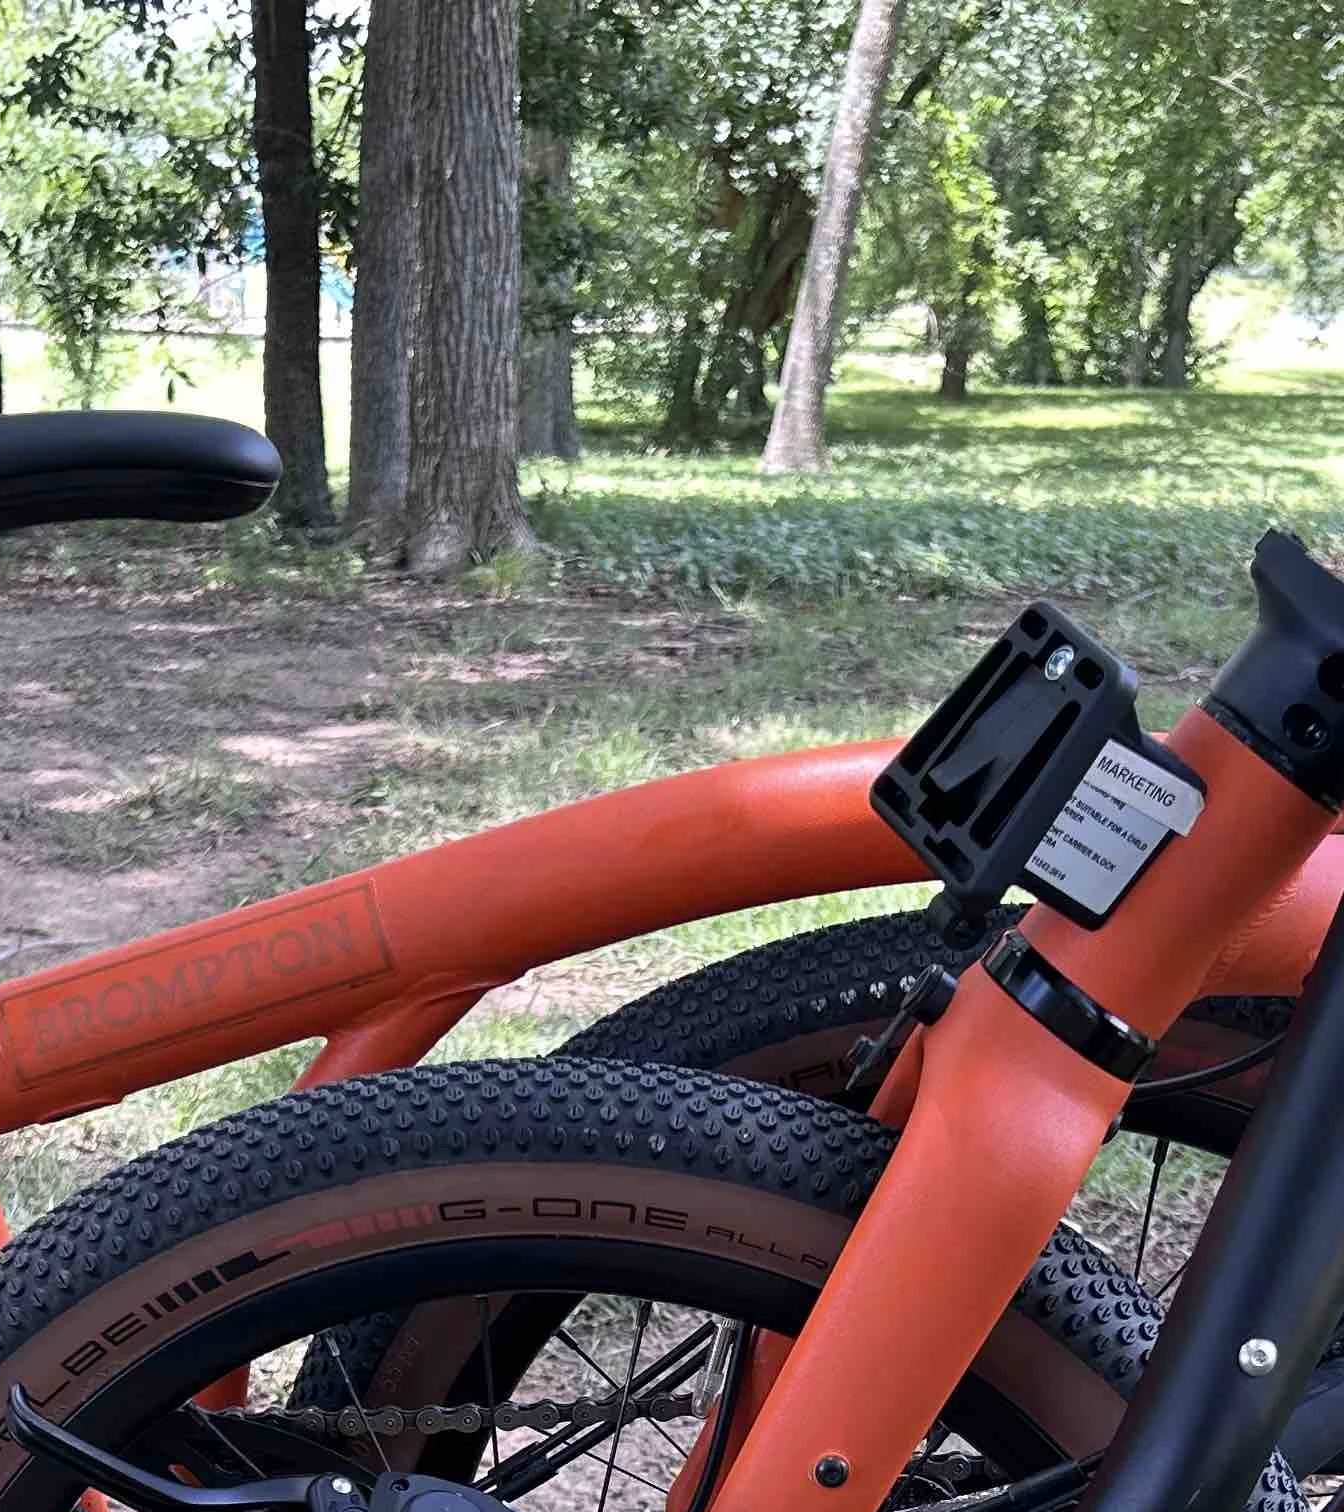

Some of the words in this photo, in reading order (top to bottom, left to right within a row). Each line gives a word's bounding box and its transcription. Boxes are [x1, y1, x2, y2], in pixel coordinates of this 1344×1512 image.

[1097, 756, 1176, 807] MARKETING
[28, 912, 358, 1054] BROMPTON
[439, 1198, 689, 1232] G-ONE
